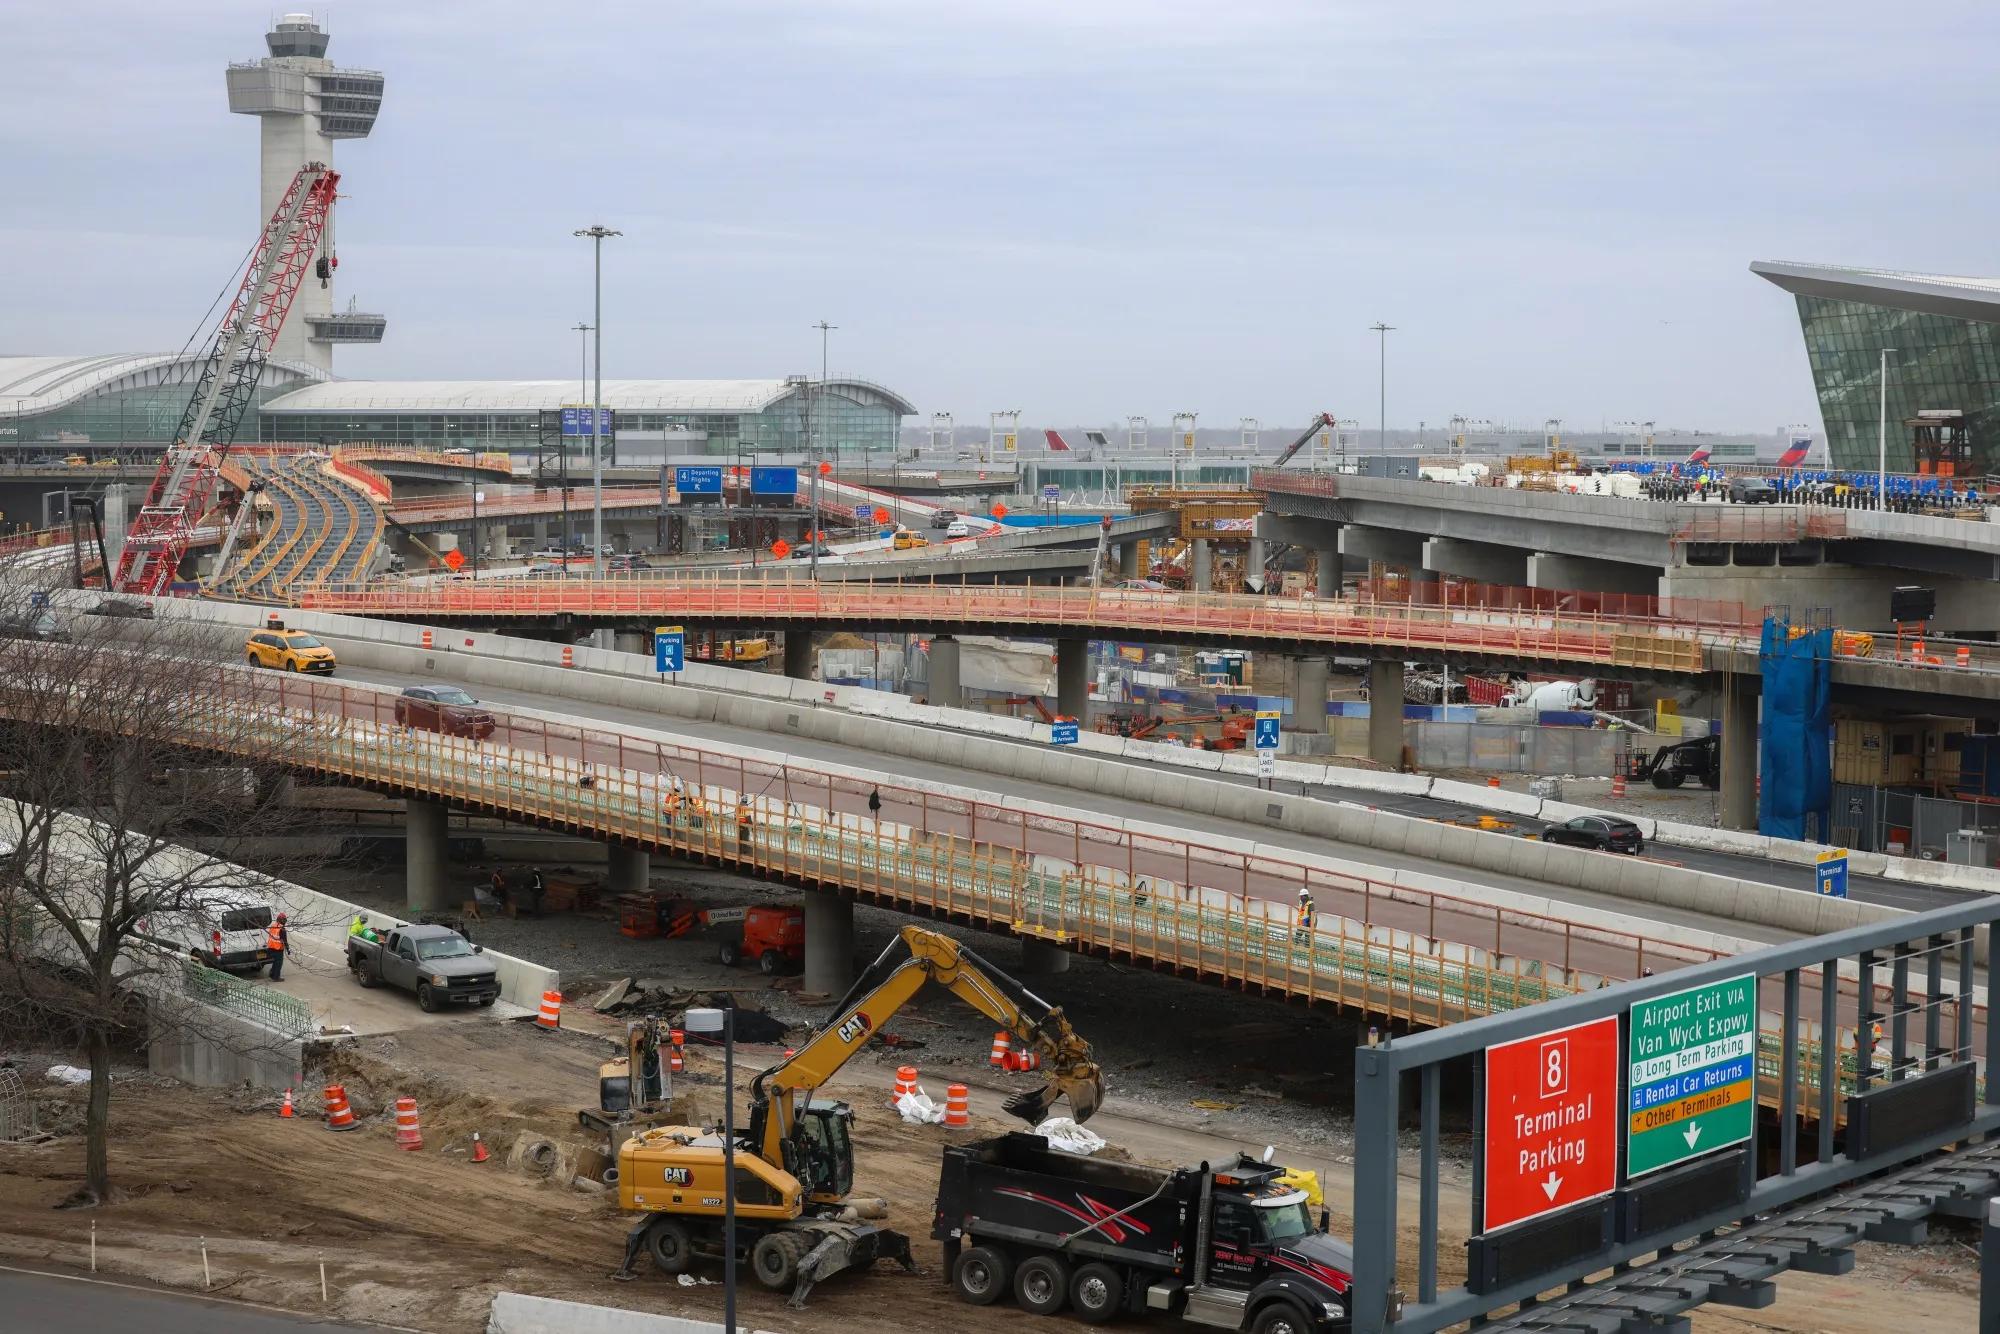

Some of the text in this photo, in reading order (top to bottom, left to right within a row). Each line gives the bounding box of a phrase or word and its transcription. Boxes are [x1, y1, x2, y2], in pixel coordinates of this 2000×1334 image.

[691, 469, 719, 477] Departing
[1820, 864, 1843, 877] Terminal
[716, 911, 728, 919] United
[1643, 988, 1744, 1028] Airport Exit VIA
[838, 1014, 867, 1043] CAT
[1638, 1012, 1748, 1056] Van Wyck Expwy
[1547, 1049, 1561, 1088] 8
[1646, 1058, 1671, 1080] Long
[1676, 1050, 1700, 1068] Term
[1705, 1038, 1744, 1060] Parking
[1646, 1064, 1742, 1104] Rental Car Returns
[1514, 1093, 1592, 1139] Terminal
[1645, 1088, 1731, 1128] Other Terminals
[664, 1167, 687, 1183] CAT
[1519, 1137, 1585, 1175] Parking
[702, 1198, 720, 1206] M322
